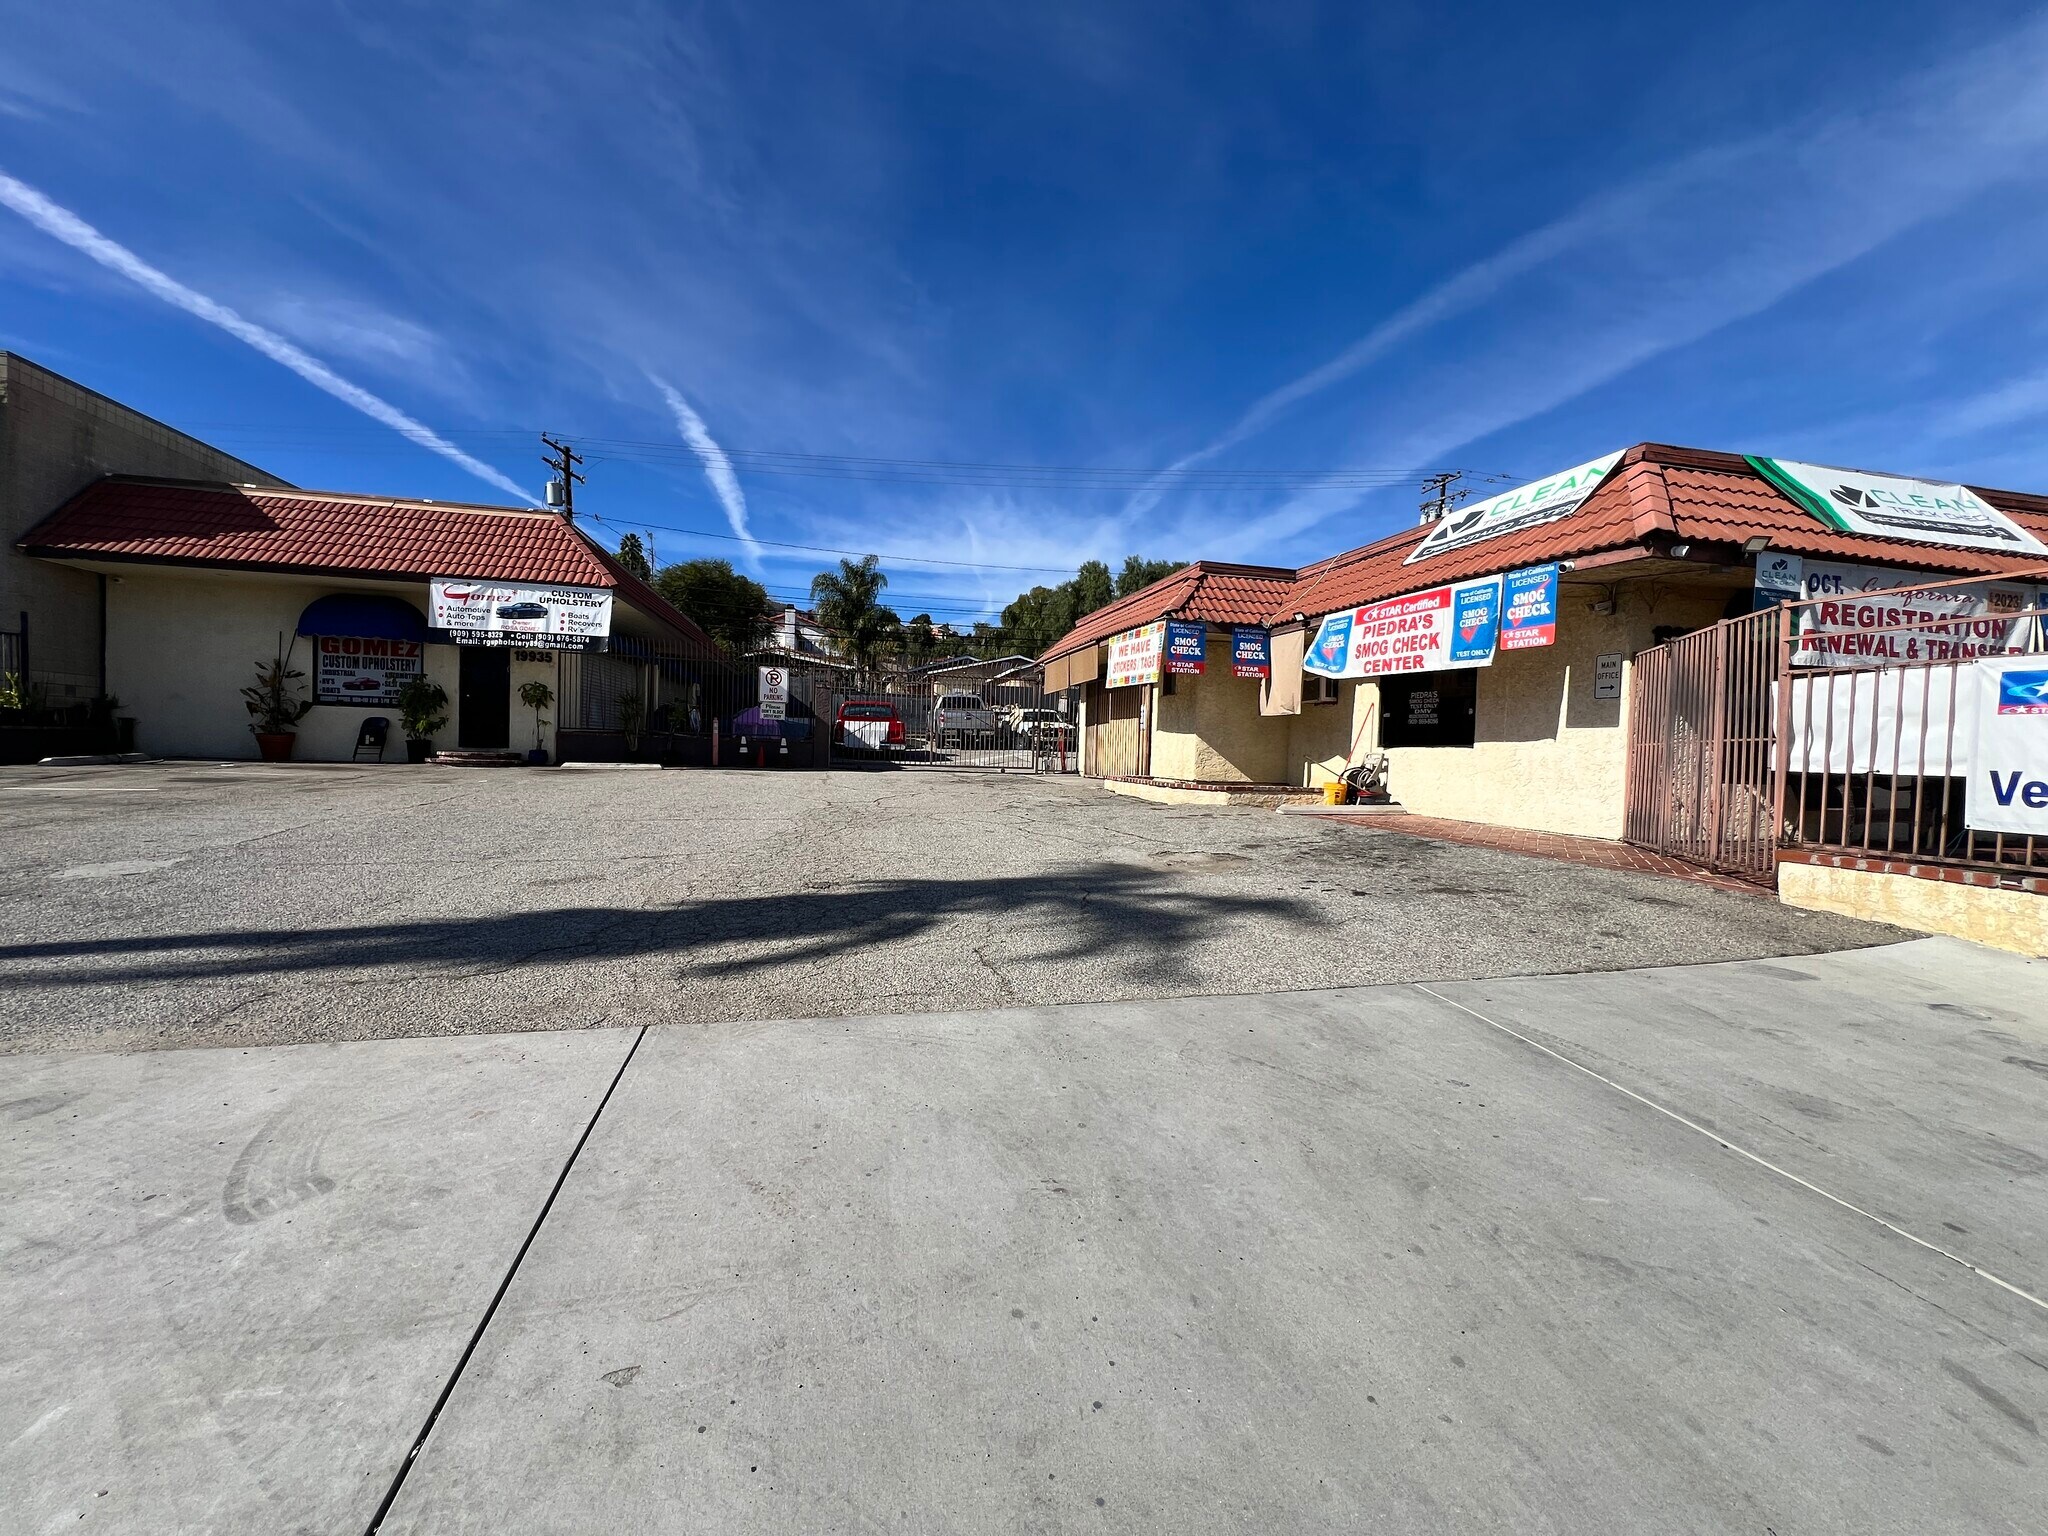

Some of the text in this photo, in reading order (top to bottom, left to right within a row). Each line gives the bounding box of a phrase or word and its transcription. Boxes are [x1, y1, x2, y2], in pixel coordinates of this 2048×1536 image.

[1490, 460, 1615, 516] CLEAN
[1870, 490, 1978, 512] CLEAN
[1484, 505, 1534, 526] TRUCK
[1890, 506, 1996, 522] TRUCK CHECK
[1528, 565, 1555, 574] California
[1762, 571, 1796, 580] CLEAN
[1512, 574, 1549, 588] LICENSED
[1808, 573, 1843, 594] OCT.
[444, 582, 512, 605] Gomez
[552, 590, 592, 599] CUSTOM
[1461, 593, 1491, 604] LICENSED
[1513, 589, 1545, 605] SMOG
[1995, 594, 2019, 607] 2023
[446, 605, 490, 614] Automotive
[539, 597, 603, 607] UPHOLSTERY
[1380, 596, 1440, 617] STAR Certified
[1463, 608, 1487, 618] SMOG
[1507, 602, 1550, 620] CHECK
[1363, 614, 1433, 639] PIEDRA'S
[1460, 616, 1488, 627] CHECK
[1821, 602, 2007, 639] REGISTRATION
[450, 630, 468, 638] (909)
[1515, 629, 1539, 638] STAR
[321, 637, 419, 657] GOMEZ
[1119, 645, 1129, 657] WE
[1131, 639, 1150, 655] HAVE
[1175, 637, 1197, 646] SMOG
[1239, 642, 1261, 650] SMOG
[1355, 632, 1440, 659] SMOG CHECK
[1507, 637, 1546, 648] STATION
[1802, 629, 1899, 657] RENEWAL
[1906, 638, 1918, 659] &
[514, 650, 552, 663] 19935
[1170, 646, 1201, 655] CHECK
[1236, 651, 1265, 660] CHECK
[323, 655, 416, 671] CUSTOM UPHOLSTERY
[1113, 659, 1136, 674] STICKERS
[1141, 655, 1155, 669] TAGS
[1364, 655, 1424, 673] CENTER
[1598, 672, 1618, 680] OFFICE
[1989, 770, 2048, 808] Ve
